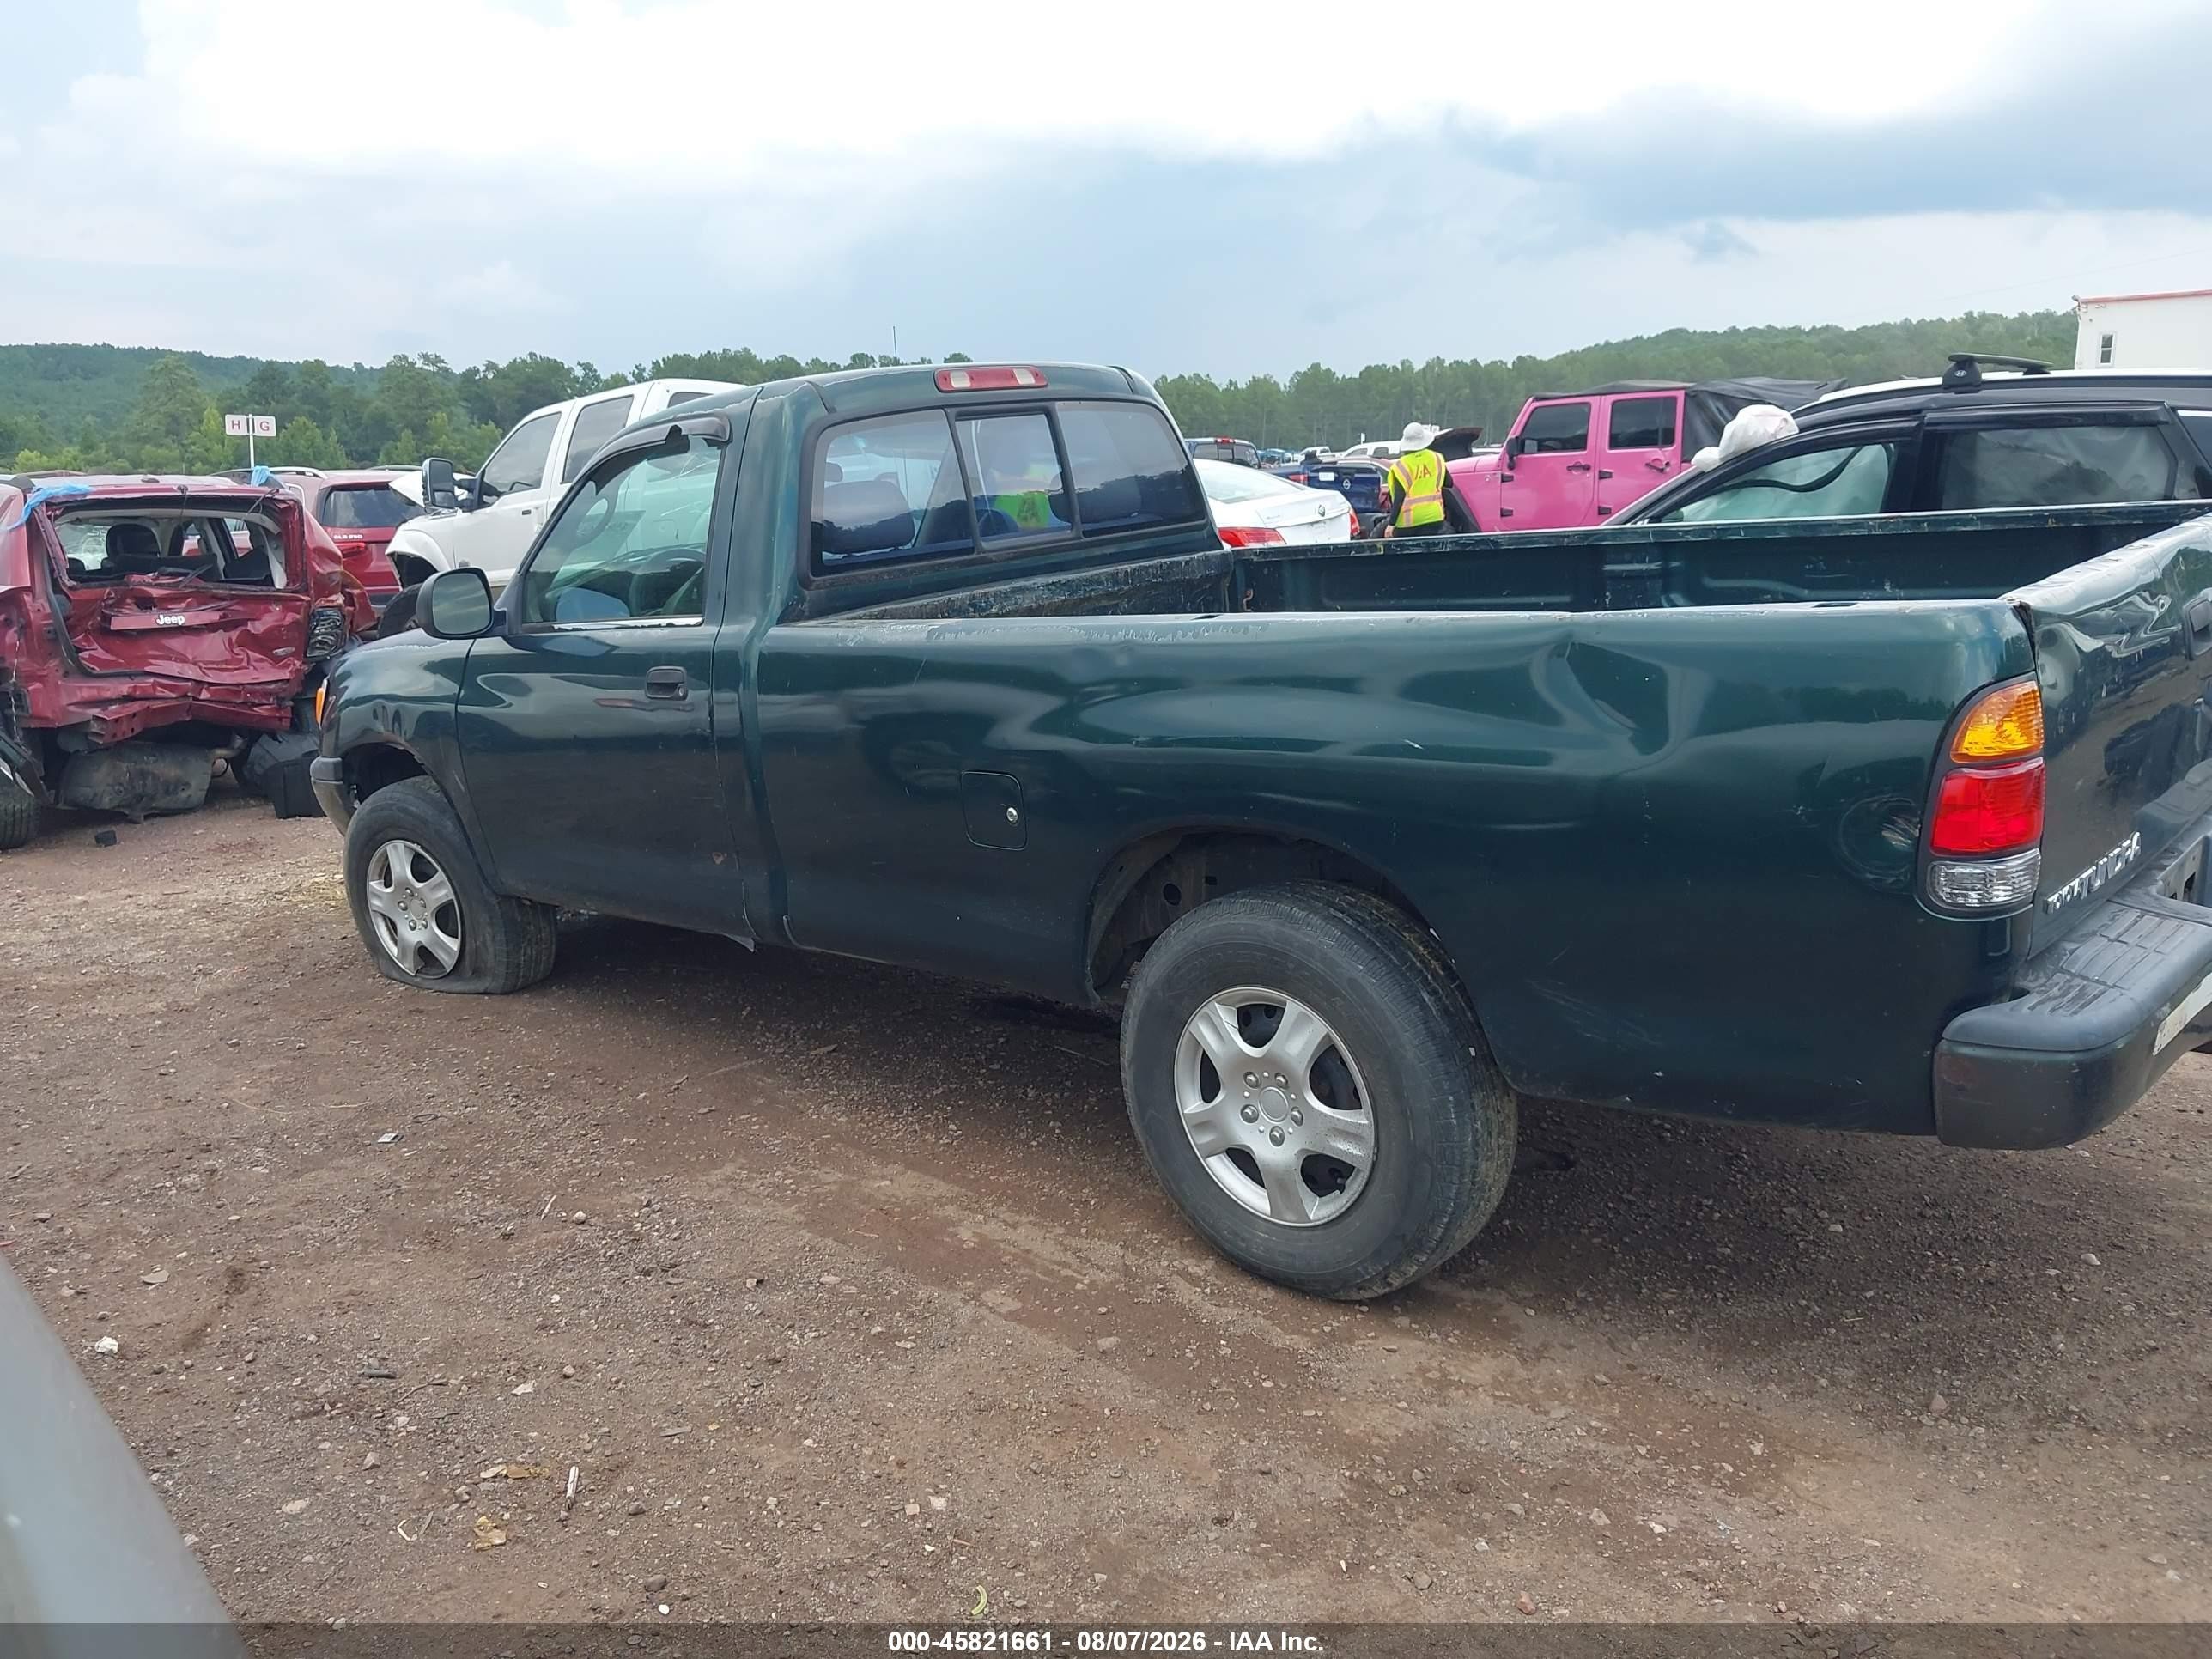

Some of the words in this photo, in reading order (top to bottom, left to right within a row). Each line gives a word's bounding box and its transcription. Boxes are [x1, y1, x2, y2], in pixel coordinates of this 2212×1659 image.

[231, 420, 241, 430] H
[259, 421, 270, 432] G
[1414, 464, 1432, 480] IA
[155, 614, 185, 626] Jeep
